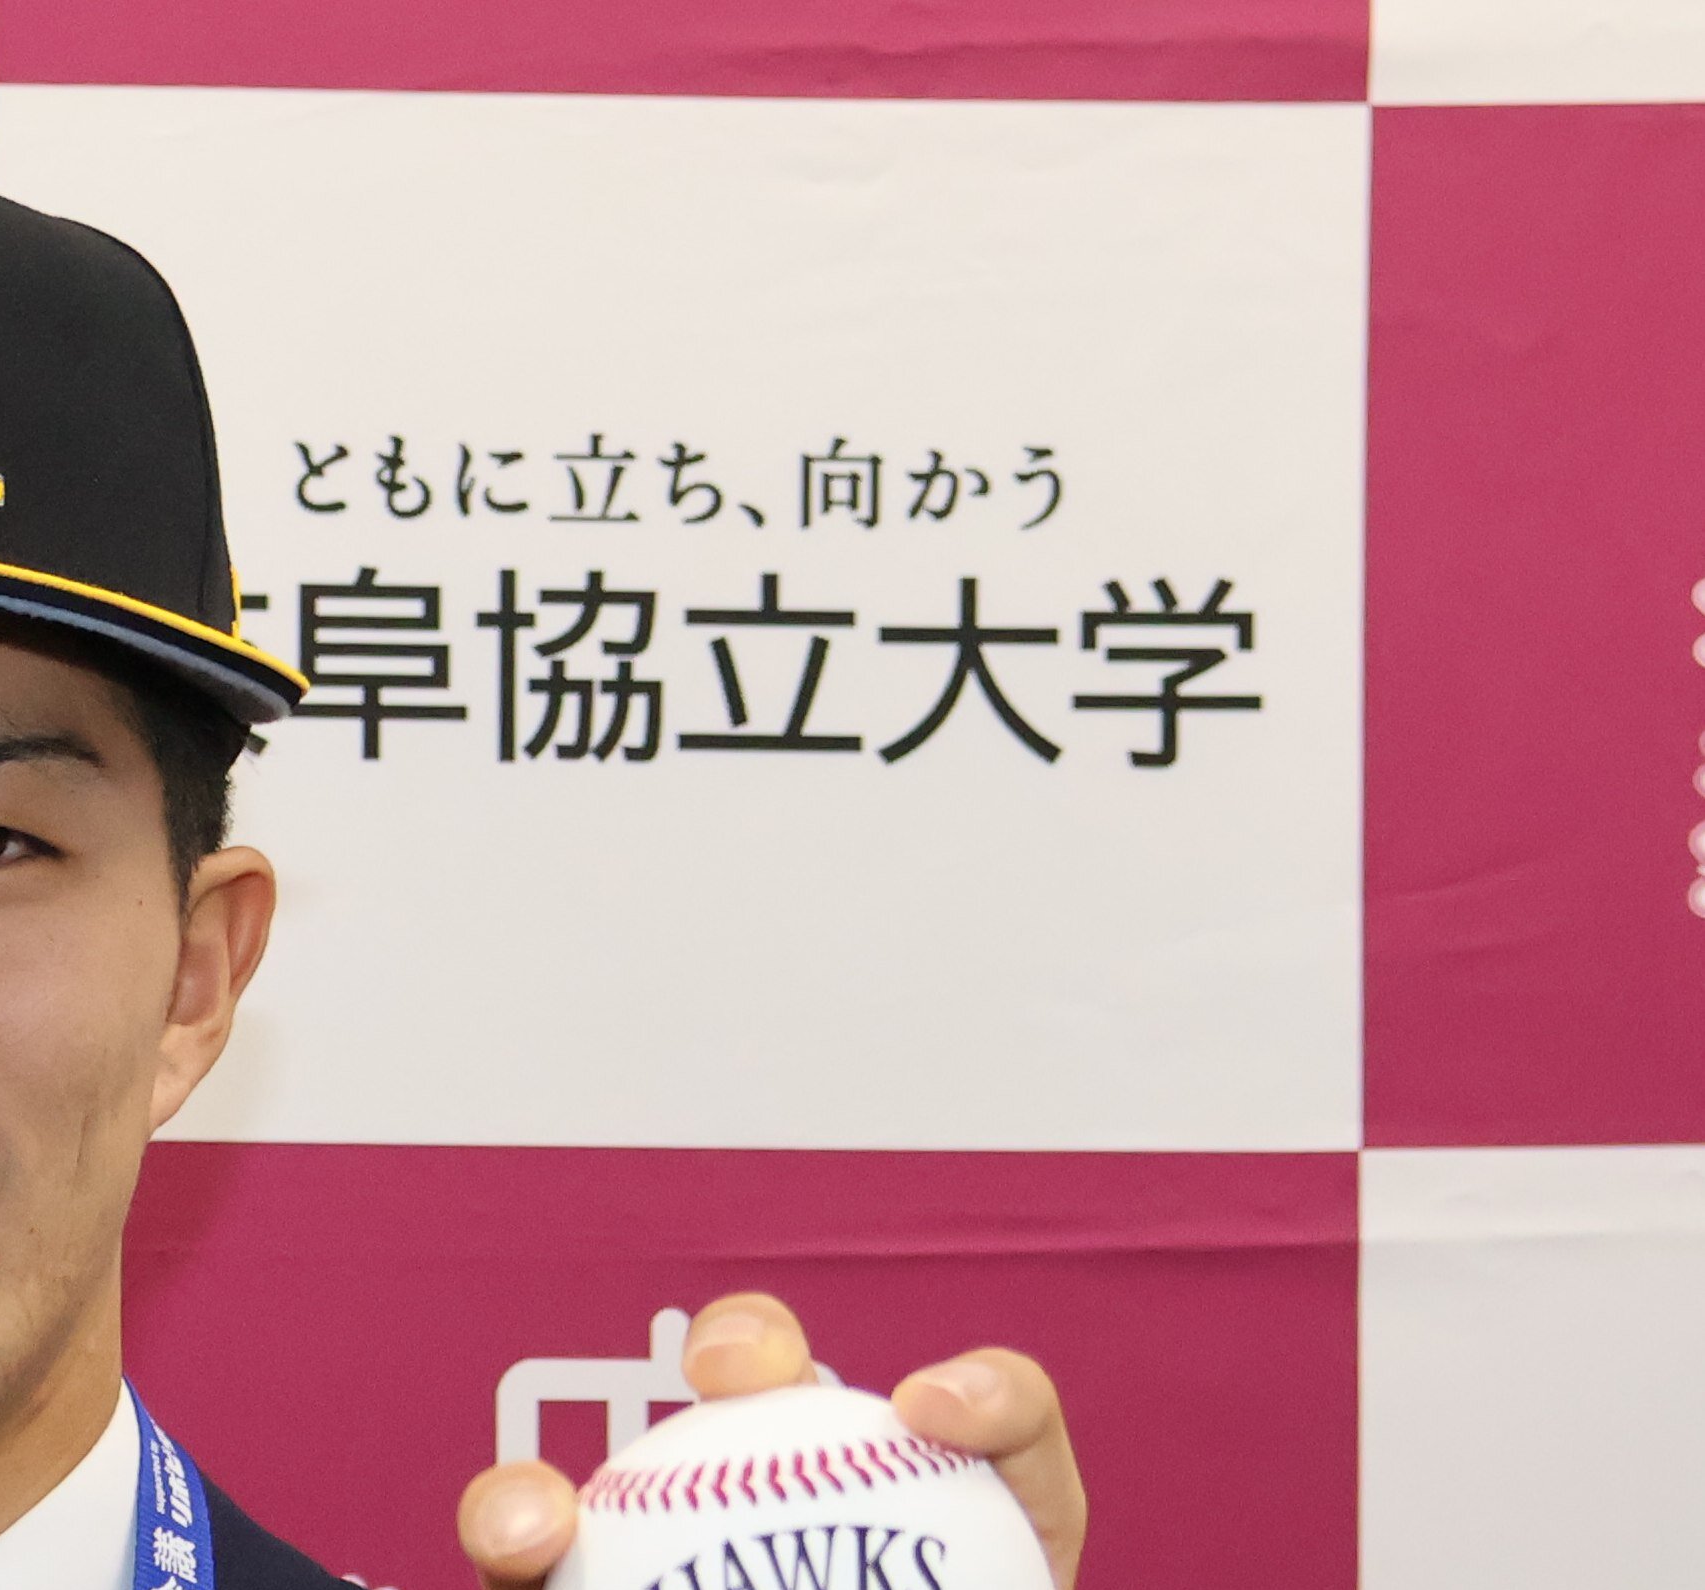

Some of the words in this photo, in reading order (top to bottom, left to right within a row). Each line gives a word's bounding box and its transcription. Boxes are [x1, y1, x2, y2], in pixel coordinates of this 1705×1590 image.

[294, 433, 1064, 529] ともに立ち、向かう
[240, 566, 1263, 768] 阜協立大学
